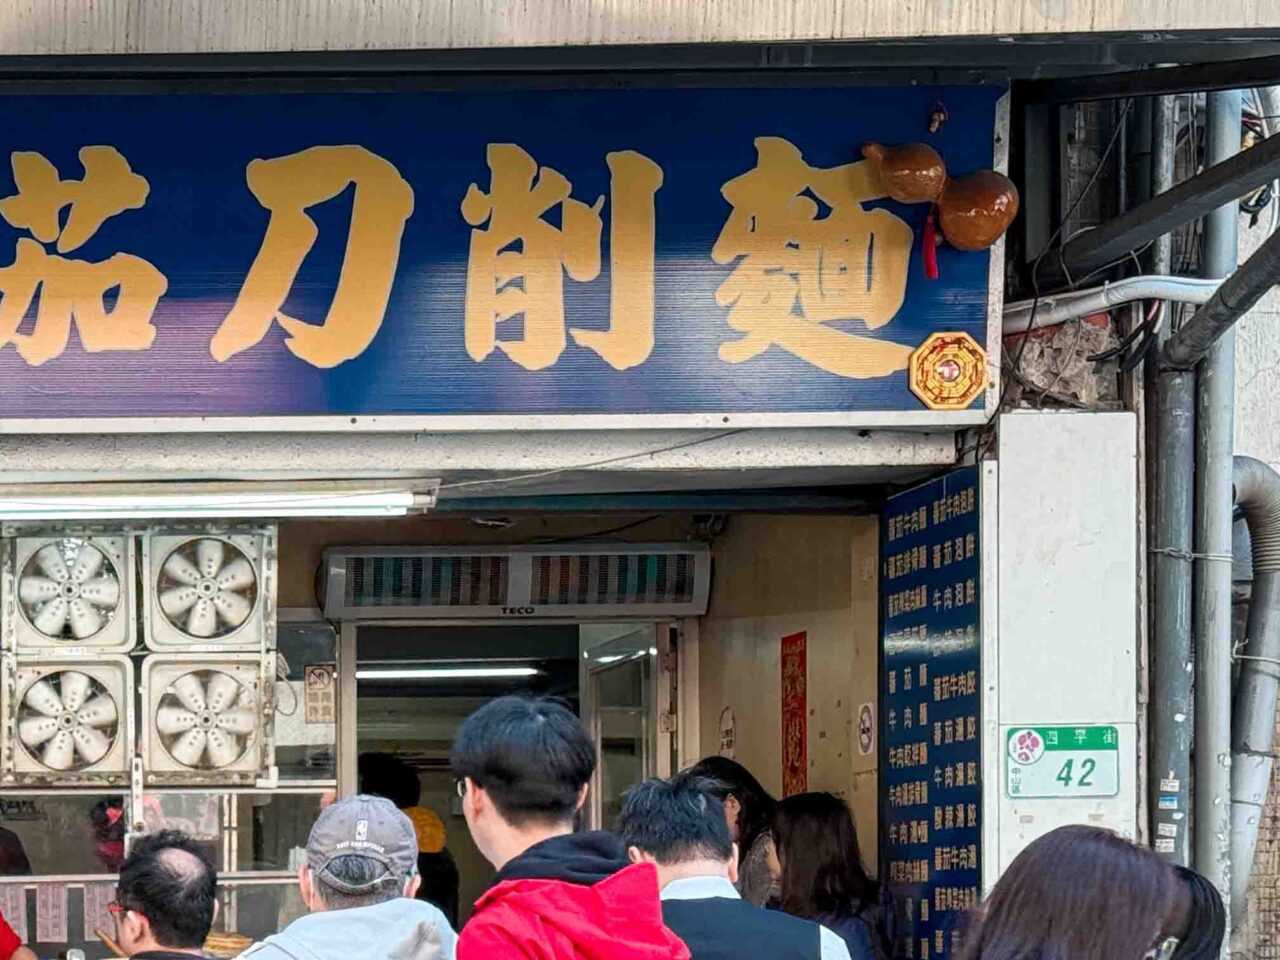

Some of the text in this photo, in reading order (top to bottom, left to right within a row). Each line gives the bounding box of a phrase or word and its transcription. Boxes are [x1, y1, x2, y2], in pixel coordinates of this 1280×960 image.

[500, 606, 535, 615] TECO
[888, 702, 928, 733] 牛肉麵
[1046, 728, 1117, 746] 四平街
[1056, 758, 1097, 787] 42
